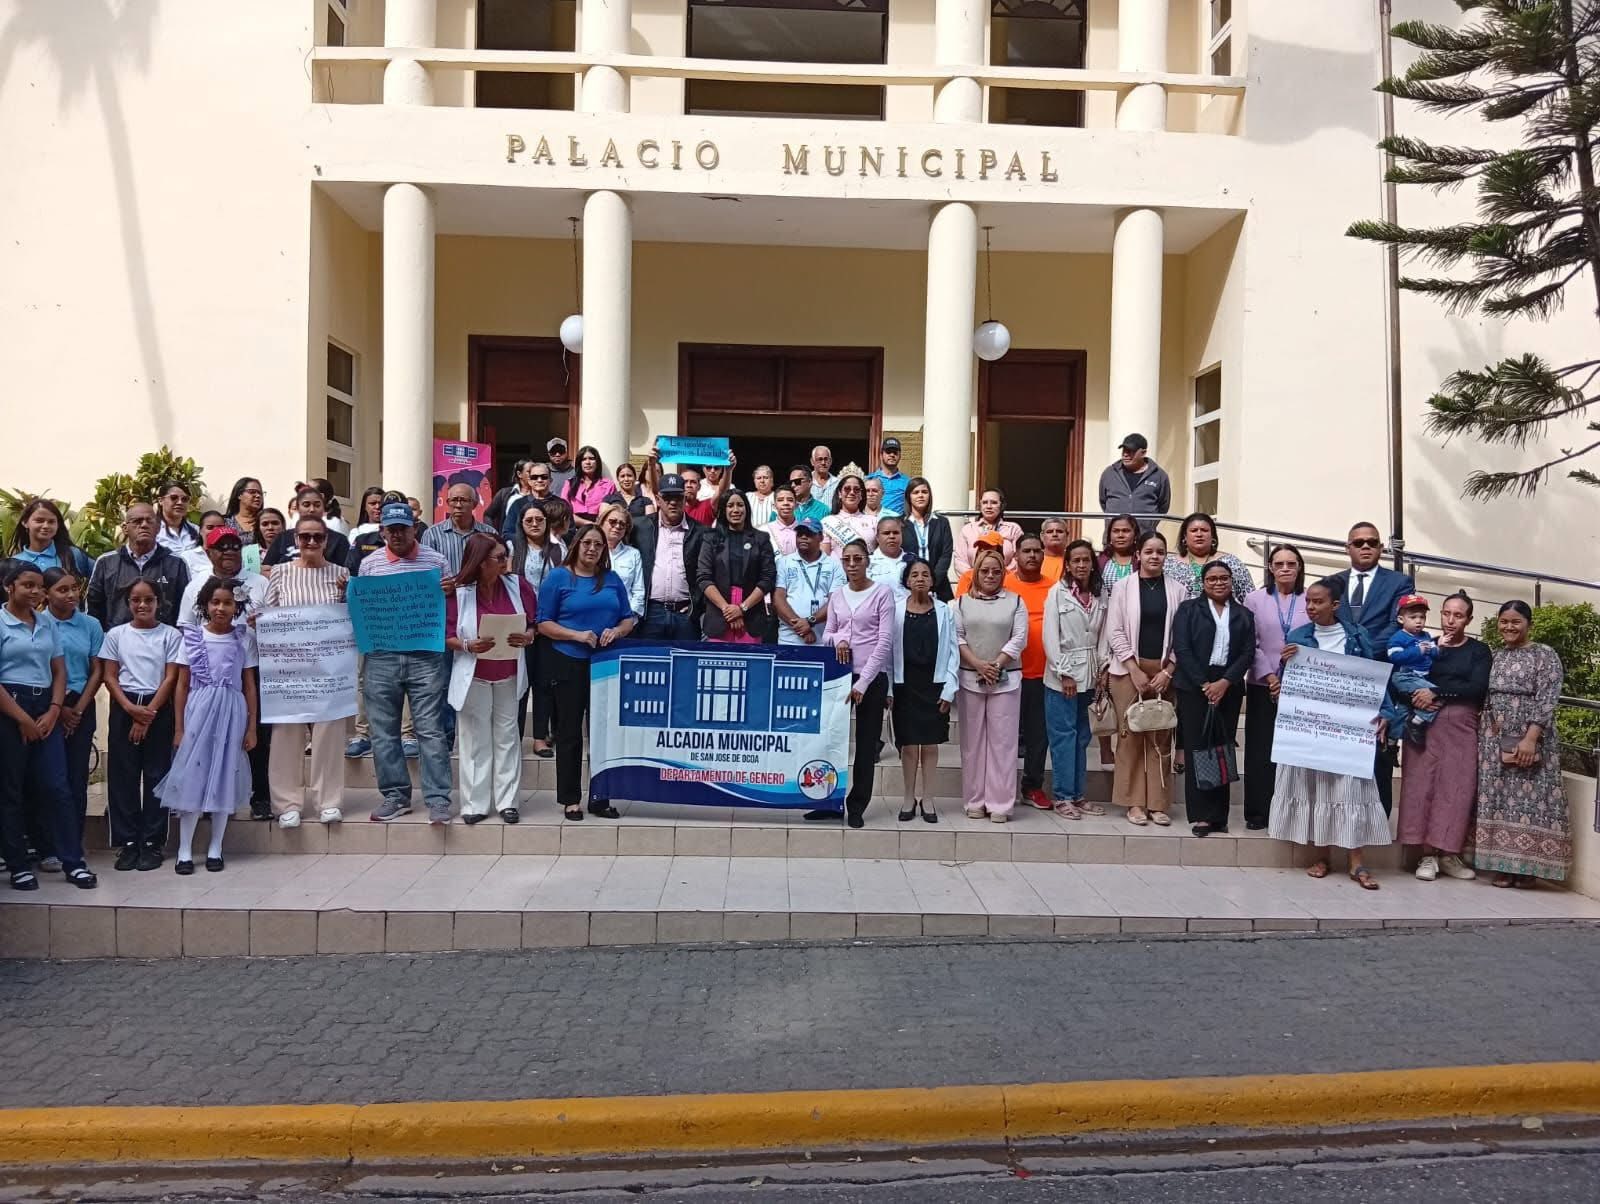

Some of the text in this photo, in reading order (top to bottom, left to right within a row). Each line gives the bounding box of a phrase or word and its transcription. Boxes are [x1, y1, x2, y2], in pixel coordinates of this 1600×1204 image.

[505, 134, 1059, 182] PALACIO MUNICIPAL
[656, 731, 792, 753] ALCADIA MUNICIPAL
[690, 752, 699, 761] DE
[700, 753, 713, 762] SAN
[715, 753, 730, 763] JOSE
[732, 754, 741, 763] DE
[660, 767, 785, 785] DEPARTAMENTO DE GENERO
